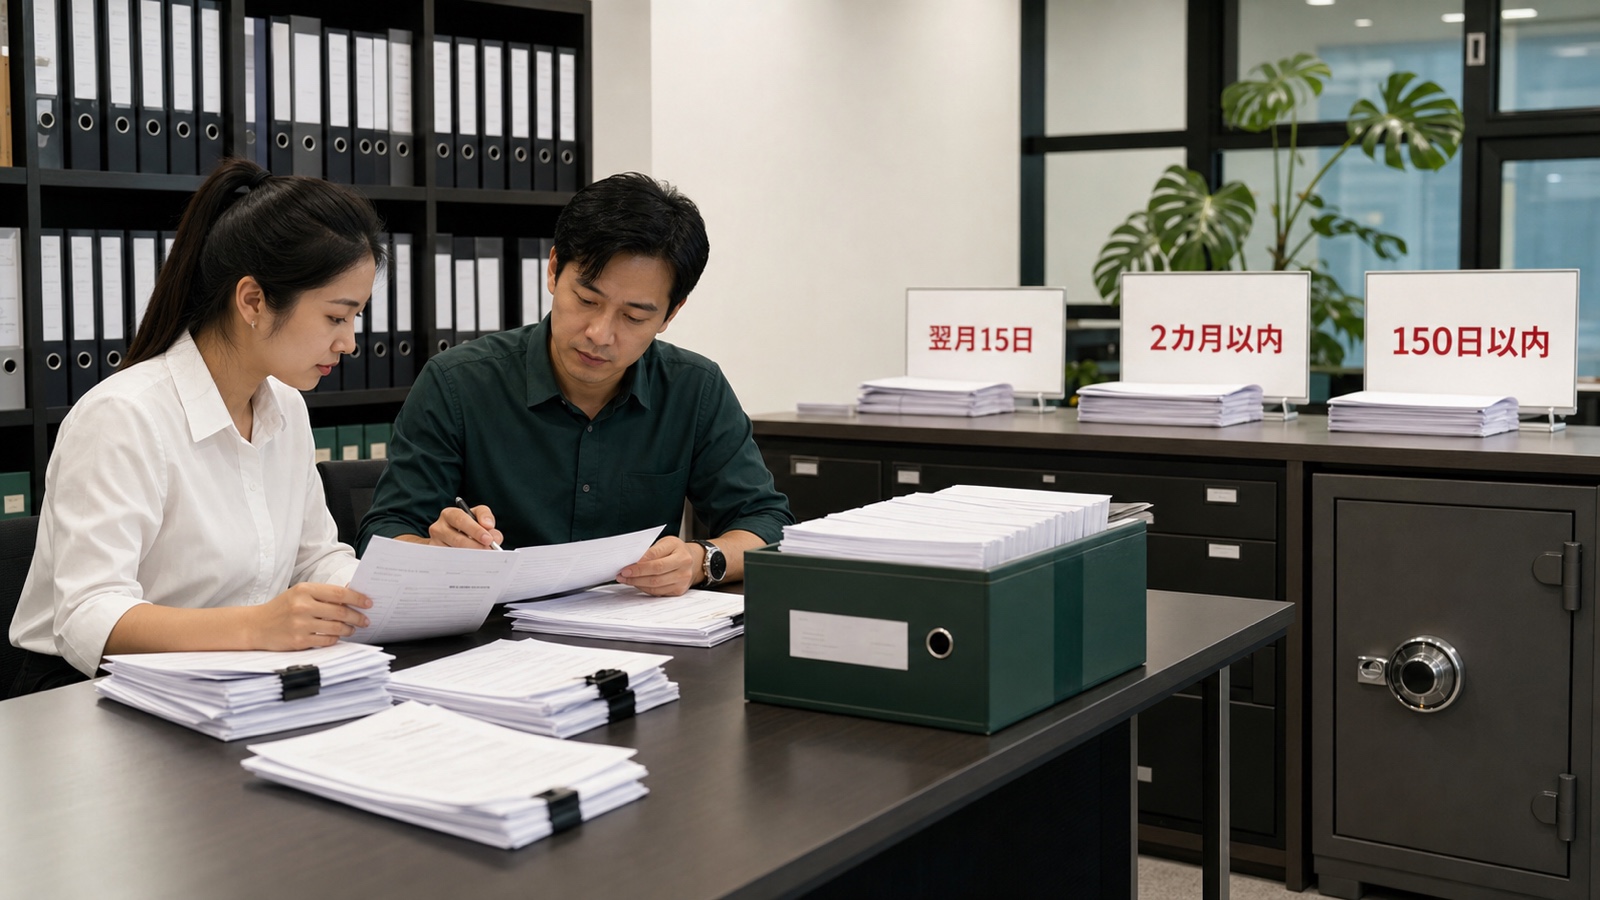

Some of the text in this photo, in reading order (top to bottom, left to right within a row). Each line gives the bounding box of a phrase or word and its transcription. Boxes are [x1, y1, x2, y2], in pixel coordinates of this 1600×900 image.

[929, 325, 1033, 353] 翌月15日
[1150, 324, 1283, 354] 2カ月以内
[1393, 325, 1550, 358] 150日以内
